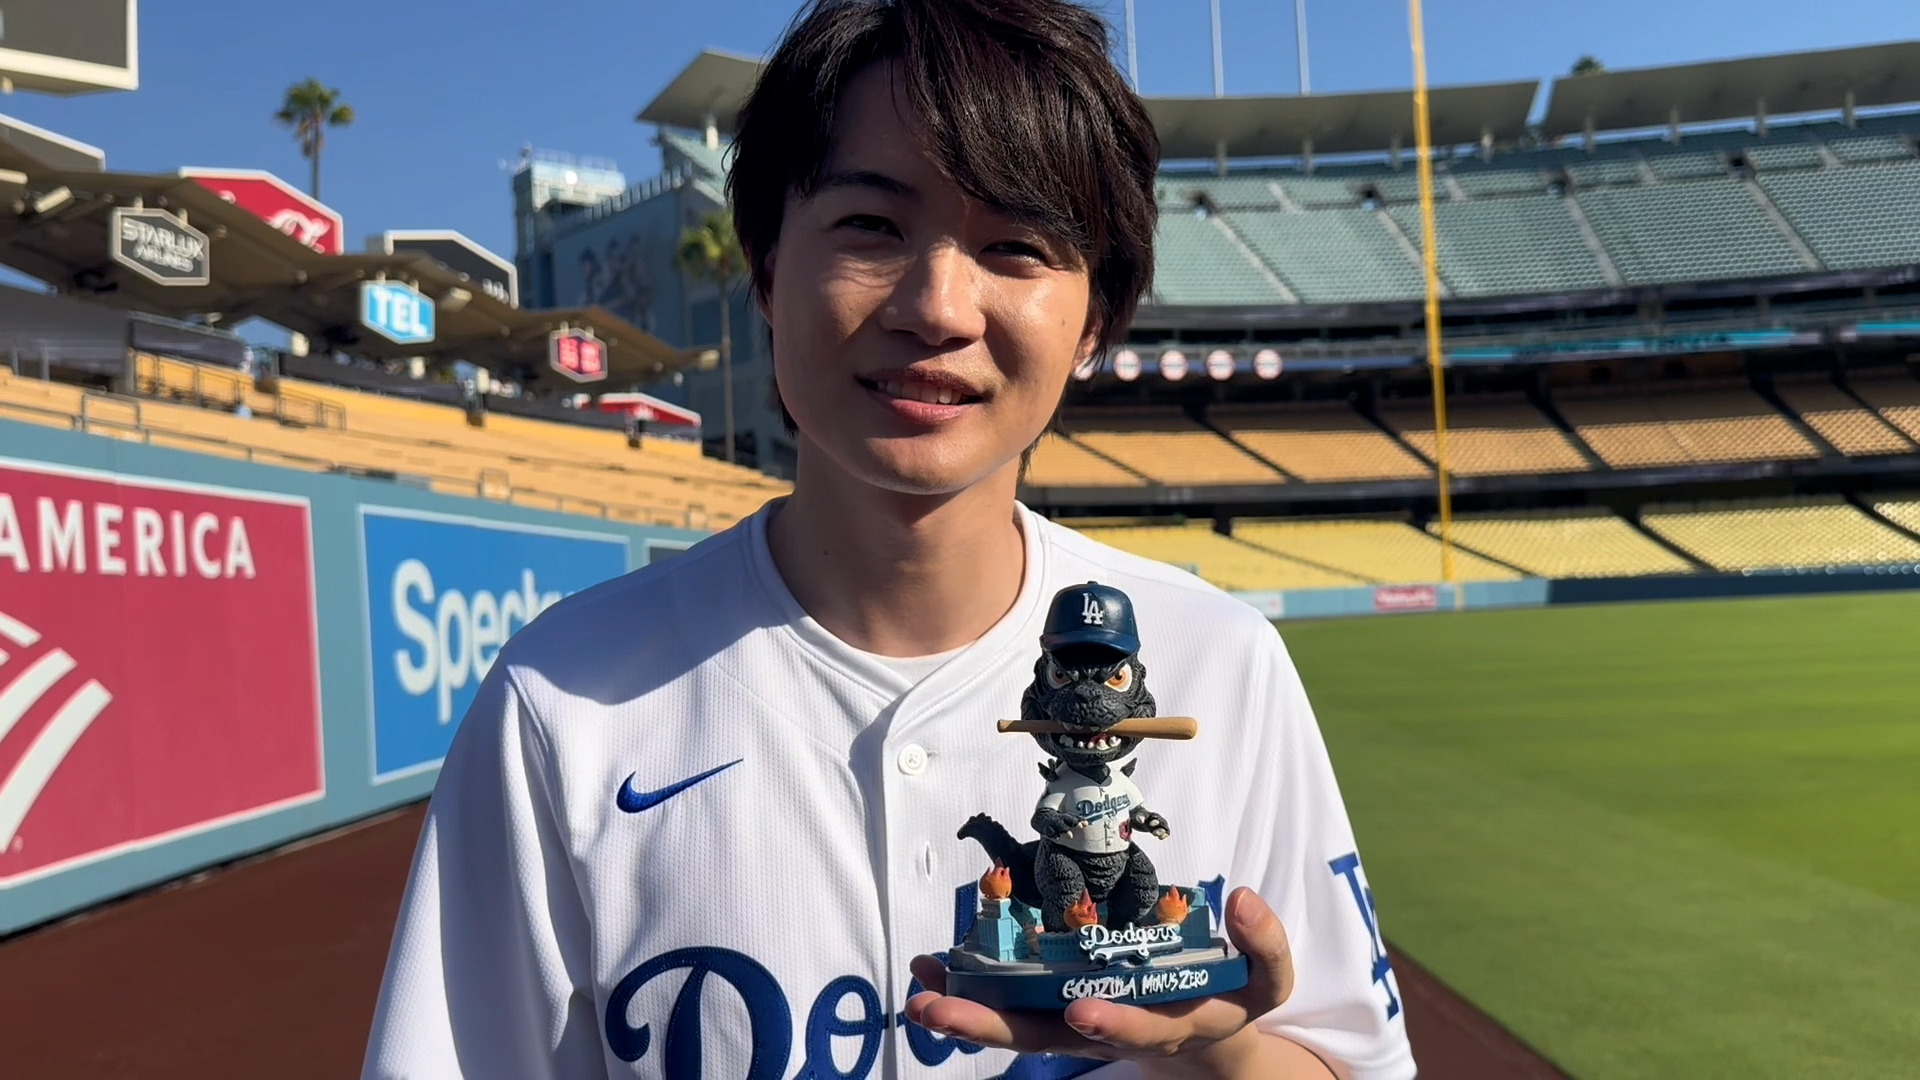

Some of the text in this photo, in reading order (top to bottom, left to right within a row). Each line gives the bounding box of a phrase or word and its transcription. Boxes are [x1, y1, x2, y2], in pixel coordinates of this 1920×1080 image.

[121, 217, 205, 261] STARLUX
[373, 287, 428, 337] TEL
[0, 492, 256, 579] AMERICA
[1082, 592, 1104, 625] LA
[1079, 921, 1183, 958] Dodgers
[1142, 972, 1177, 996] MINUS
[1178, 968, 1209, 991] ZERO
